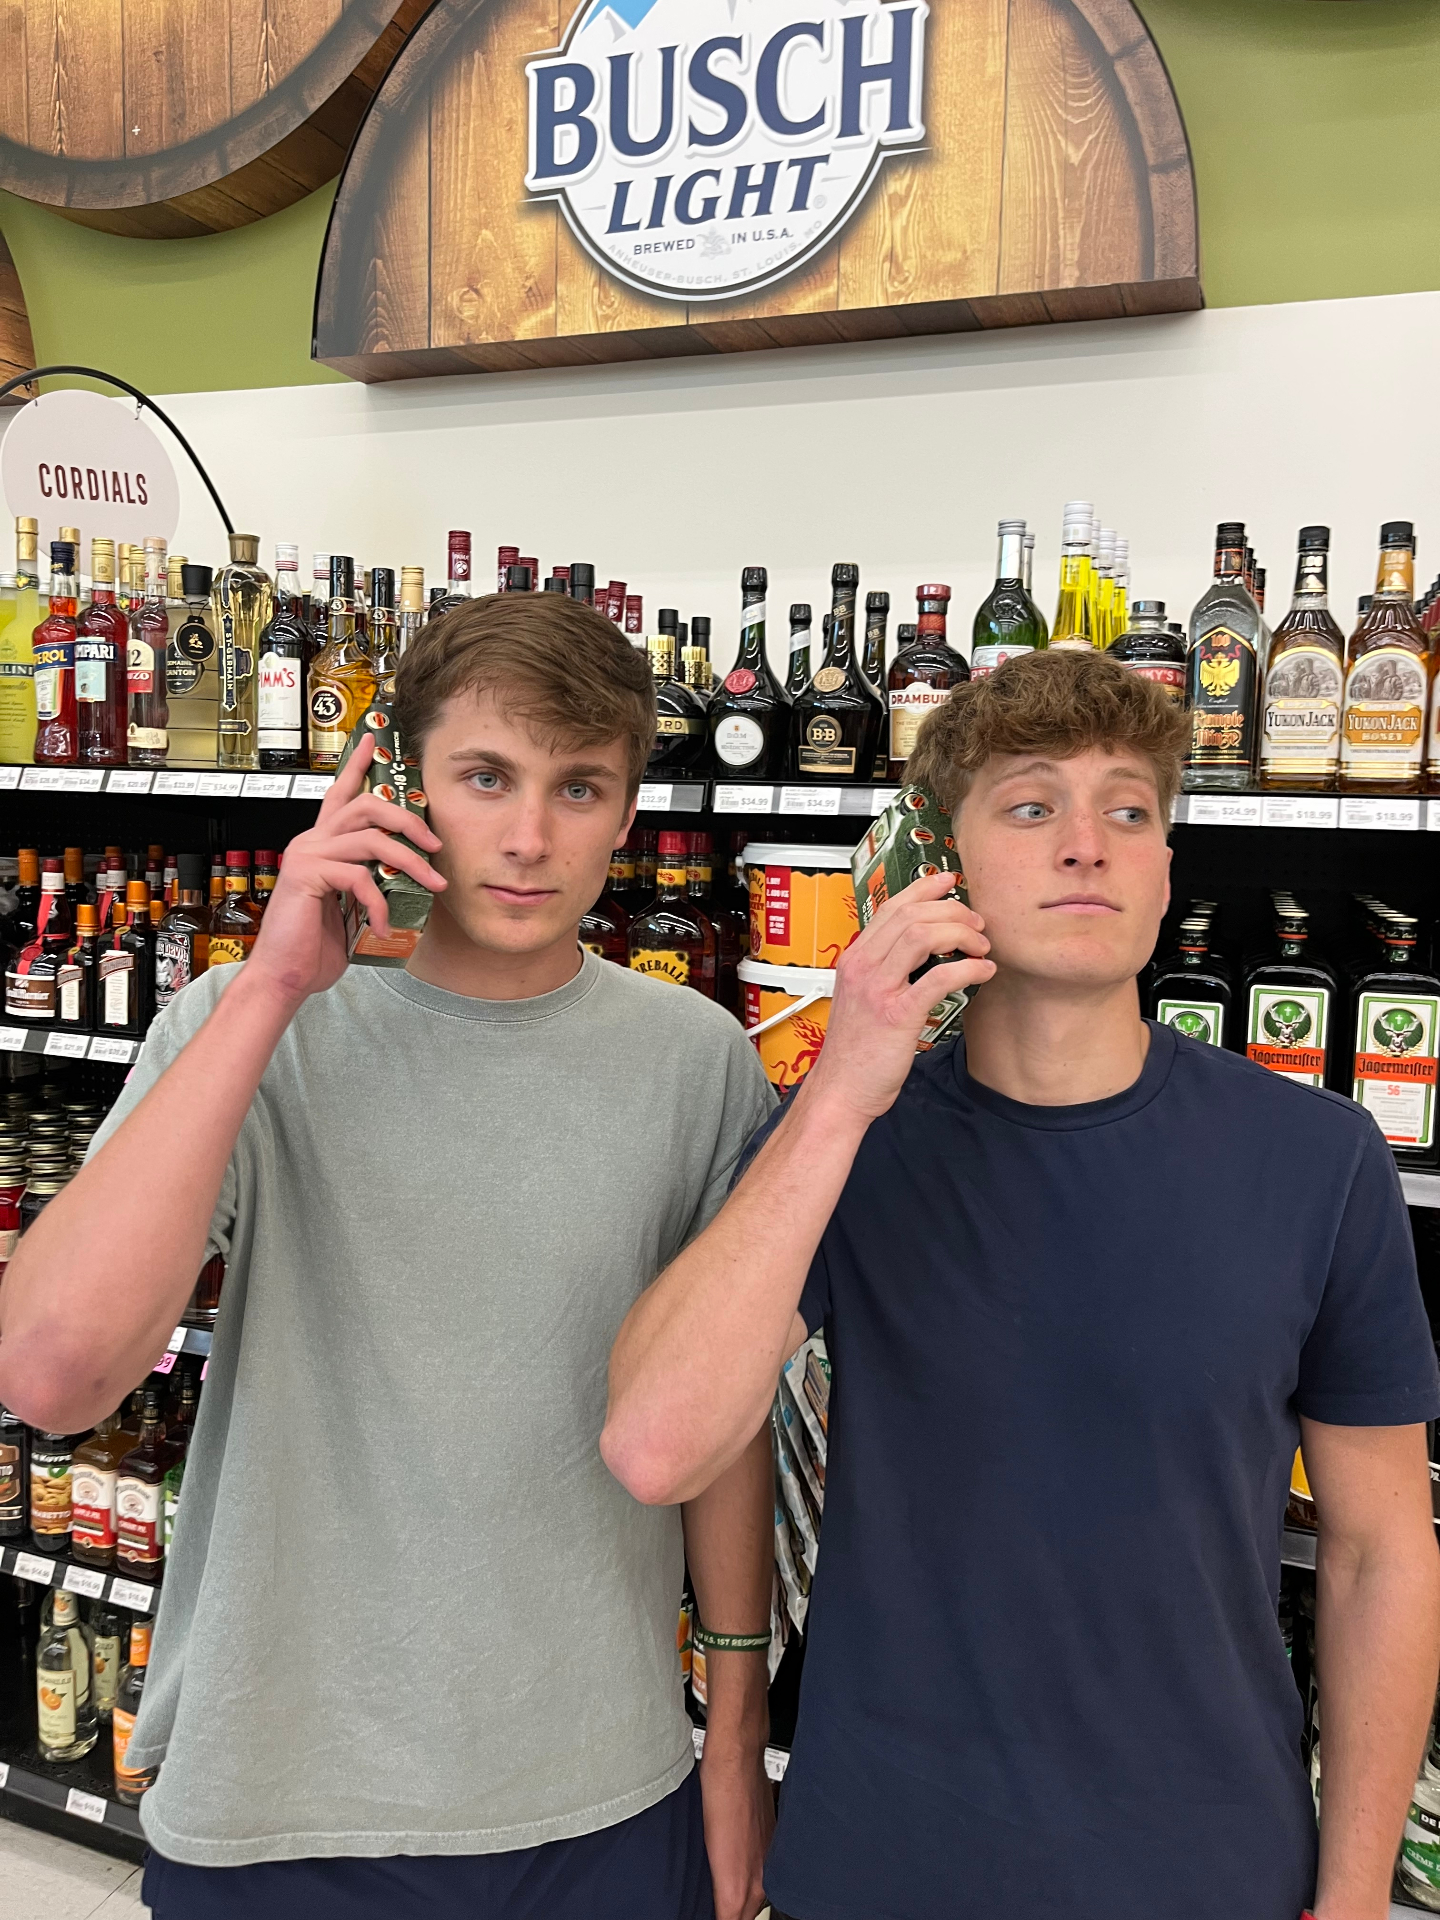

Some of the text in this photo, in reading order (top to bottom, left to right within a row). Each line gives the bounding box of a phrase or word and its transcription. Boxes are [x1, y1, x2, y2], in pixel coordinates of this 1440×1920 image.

[532, 7, 920, 181] BUSCH
[603, 154, 830, 235] LIGHT
[633, 228, 794, 255] BREWED IN U.S.A.
[37, 462, 149, 506] CORDIALS
[313, 696, 336, 716] 43
[1267, 711, 1336, 728] YUKON JACK
[1347, 714, 1419, 731] YUKON JACK
[1221, 806, 1258, 816] $24.99
[1296, 809, 1333, 820] $18.99
[1375, 811, 1414, 822] $18.99
[1387, 1085, 1401, 1096] 56
[717, 1638, 731, 1646] 1ST
[1421, 1813, 1437, 1827] DE
